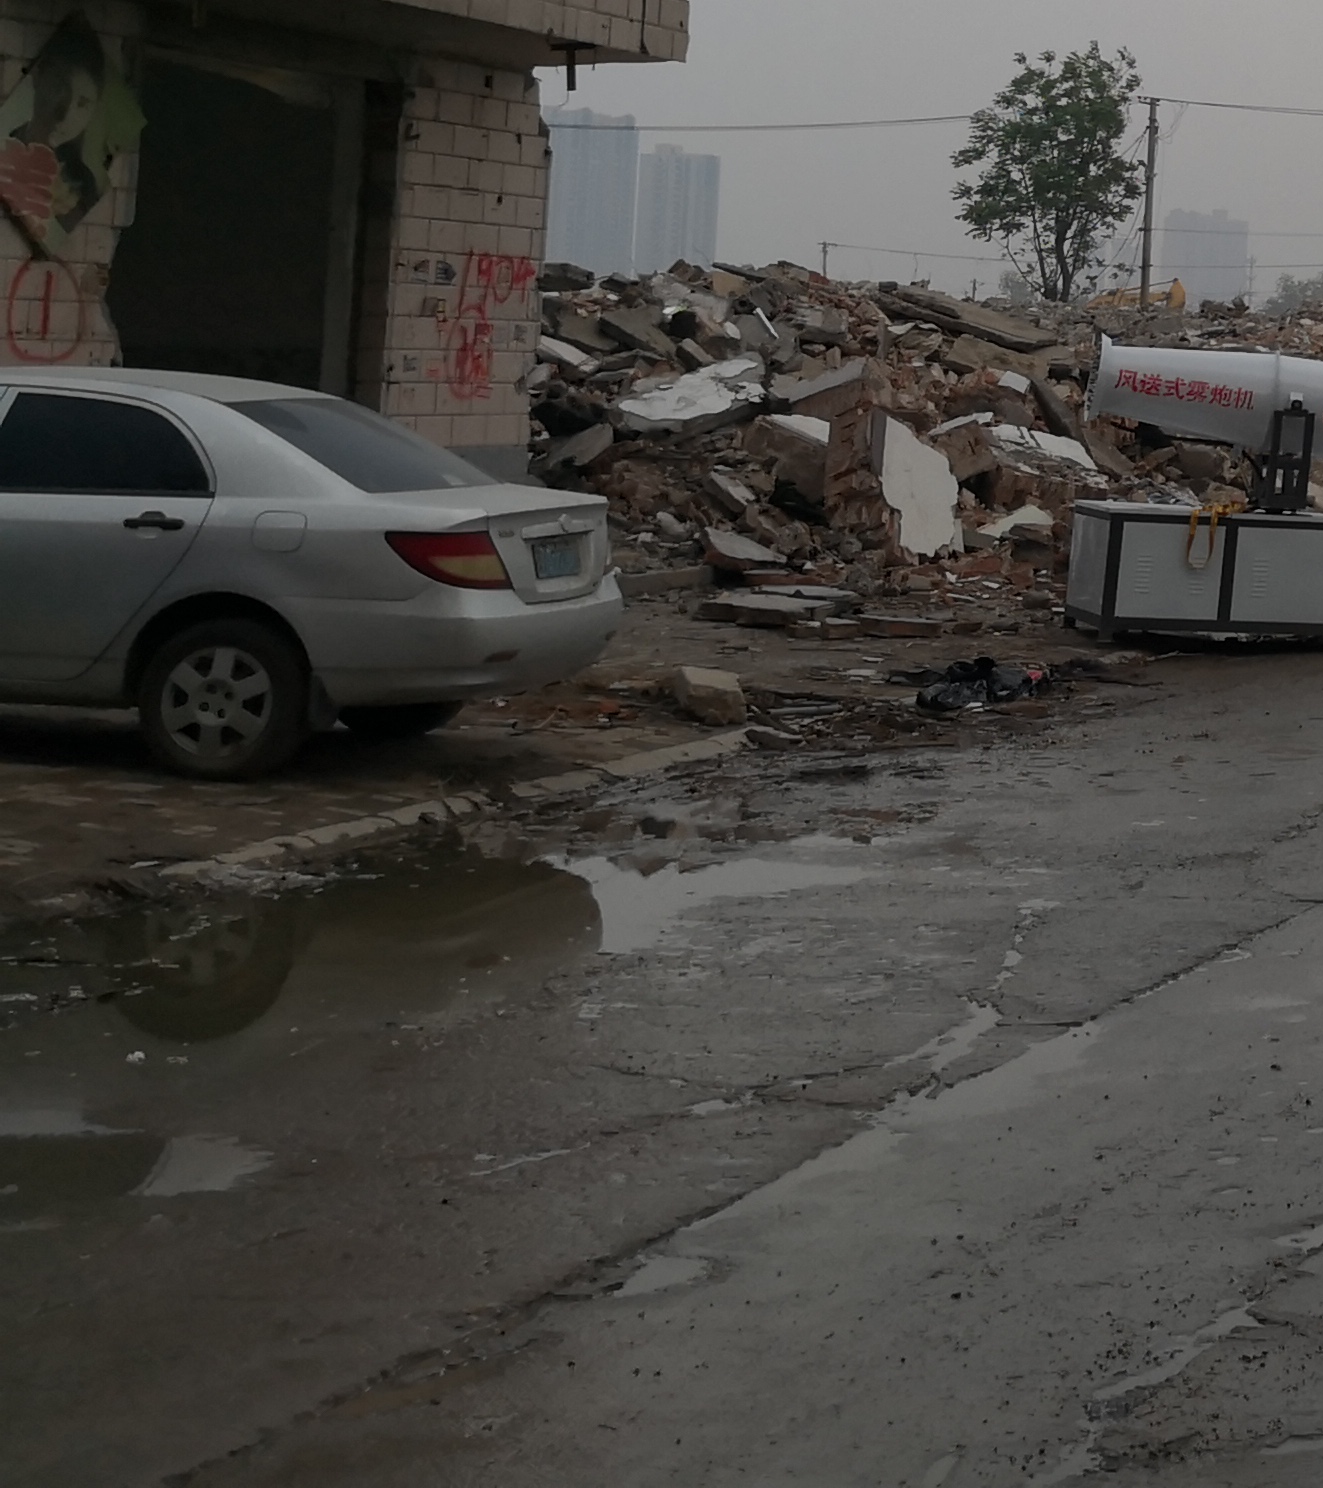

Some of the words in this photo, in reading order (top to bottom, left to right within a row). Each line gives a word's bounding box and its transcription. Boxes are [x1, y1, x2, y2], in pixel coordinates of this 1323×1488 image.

[1114, 369, 1255, 410] 风送式雾炮机
